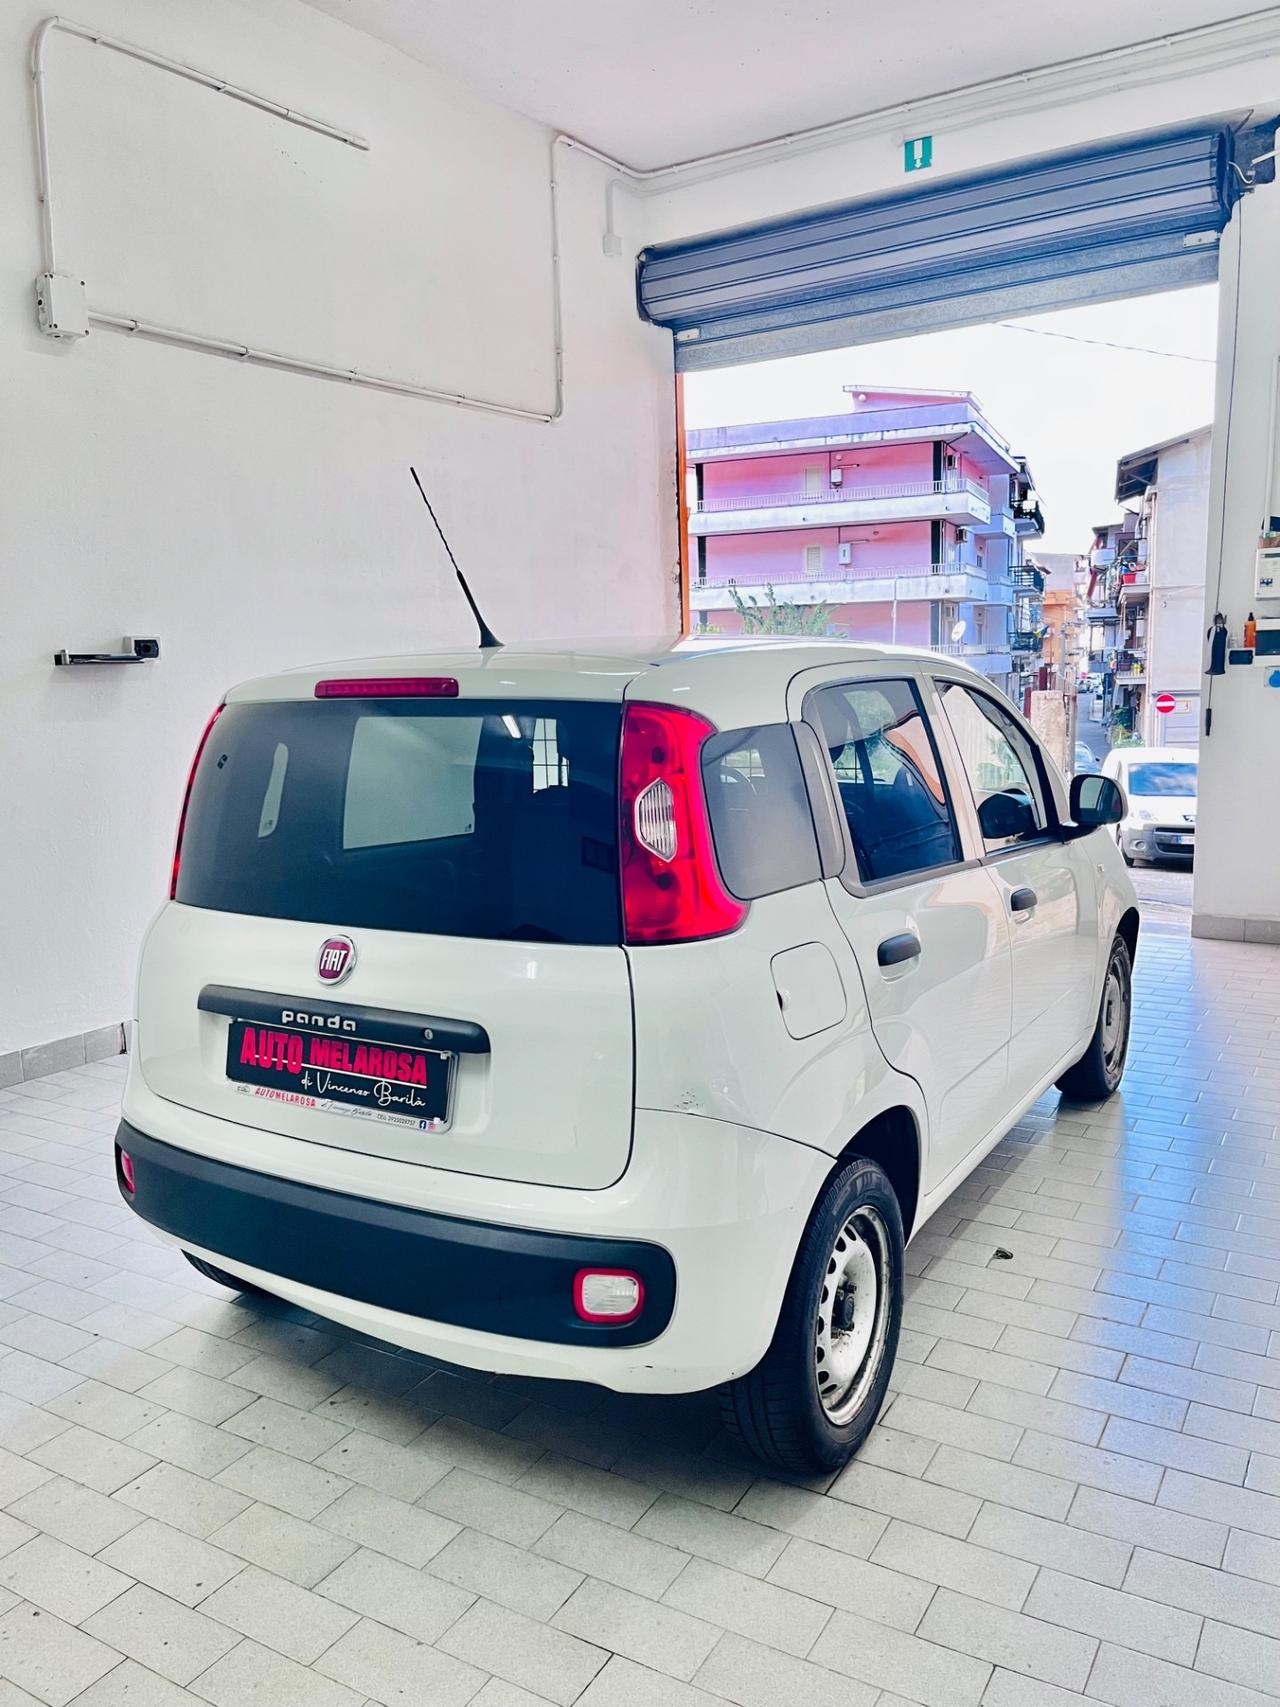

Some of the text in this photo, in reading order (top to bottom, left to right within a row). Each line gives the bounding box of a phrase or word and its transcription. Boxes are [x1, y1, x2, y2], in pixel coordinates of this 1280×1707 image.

[320, 949, 348, 971] FIAT
[282, 1010, 356, 1031] panda
[240, 1027, 427, 1084] AUTO MELAROSA
[255, 1087, 316, 1107] AUTOMELAROSA
[301, 1071, 426, 1107] di Vincenzo Barilà
